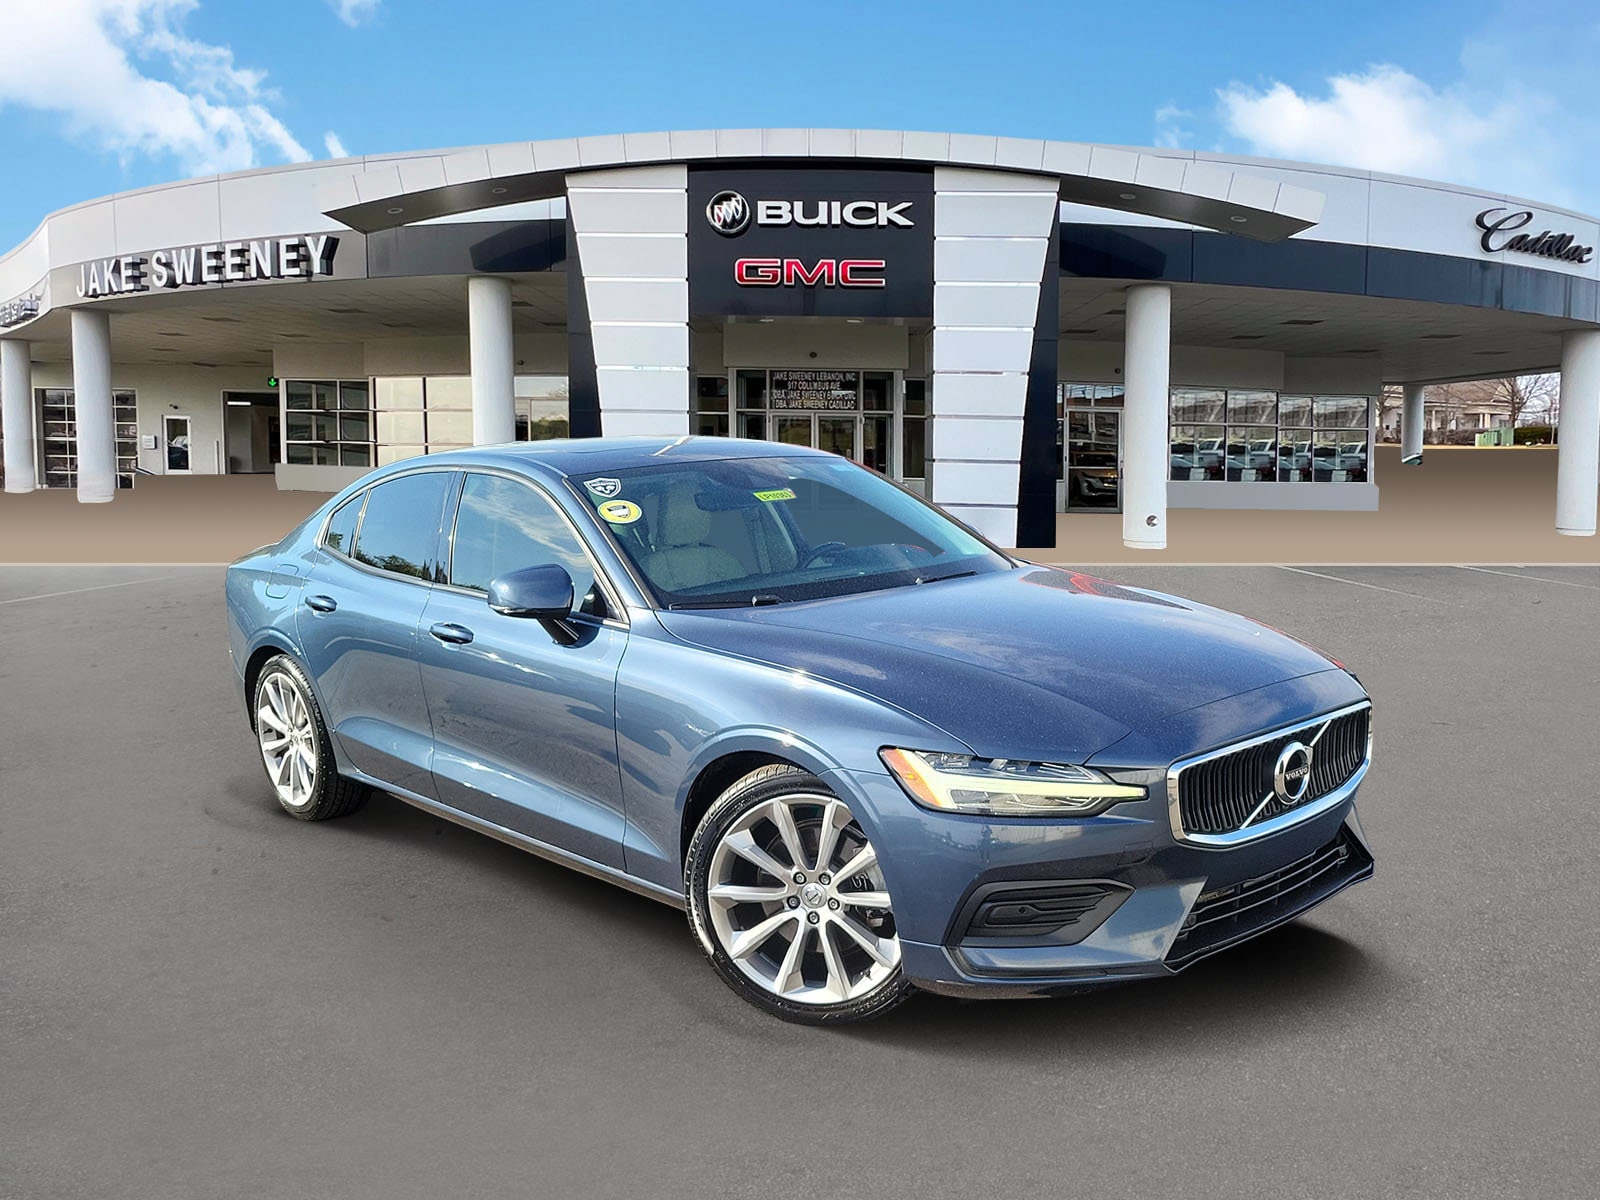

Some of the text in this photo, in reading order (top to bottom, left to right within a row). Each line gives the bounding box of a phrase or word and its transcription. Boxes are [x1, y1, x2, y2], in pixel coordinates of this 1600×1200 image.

[757, 200, 915, 226] BUICK
[1475, 207, 1593, 264] Cadillac
[76, 234, 335, 298] JAKE SWEENEY
[734, 258, 886, 287] GMC
[773, 371, 788, 381] JAKE
[788, 371, 815, 381] SWEENEY
[1285, 767, 1308, 780] VOLVO
